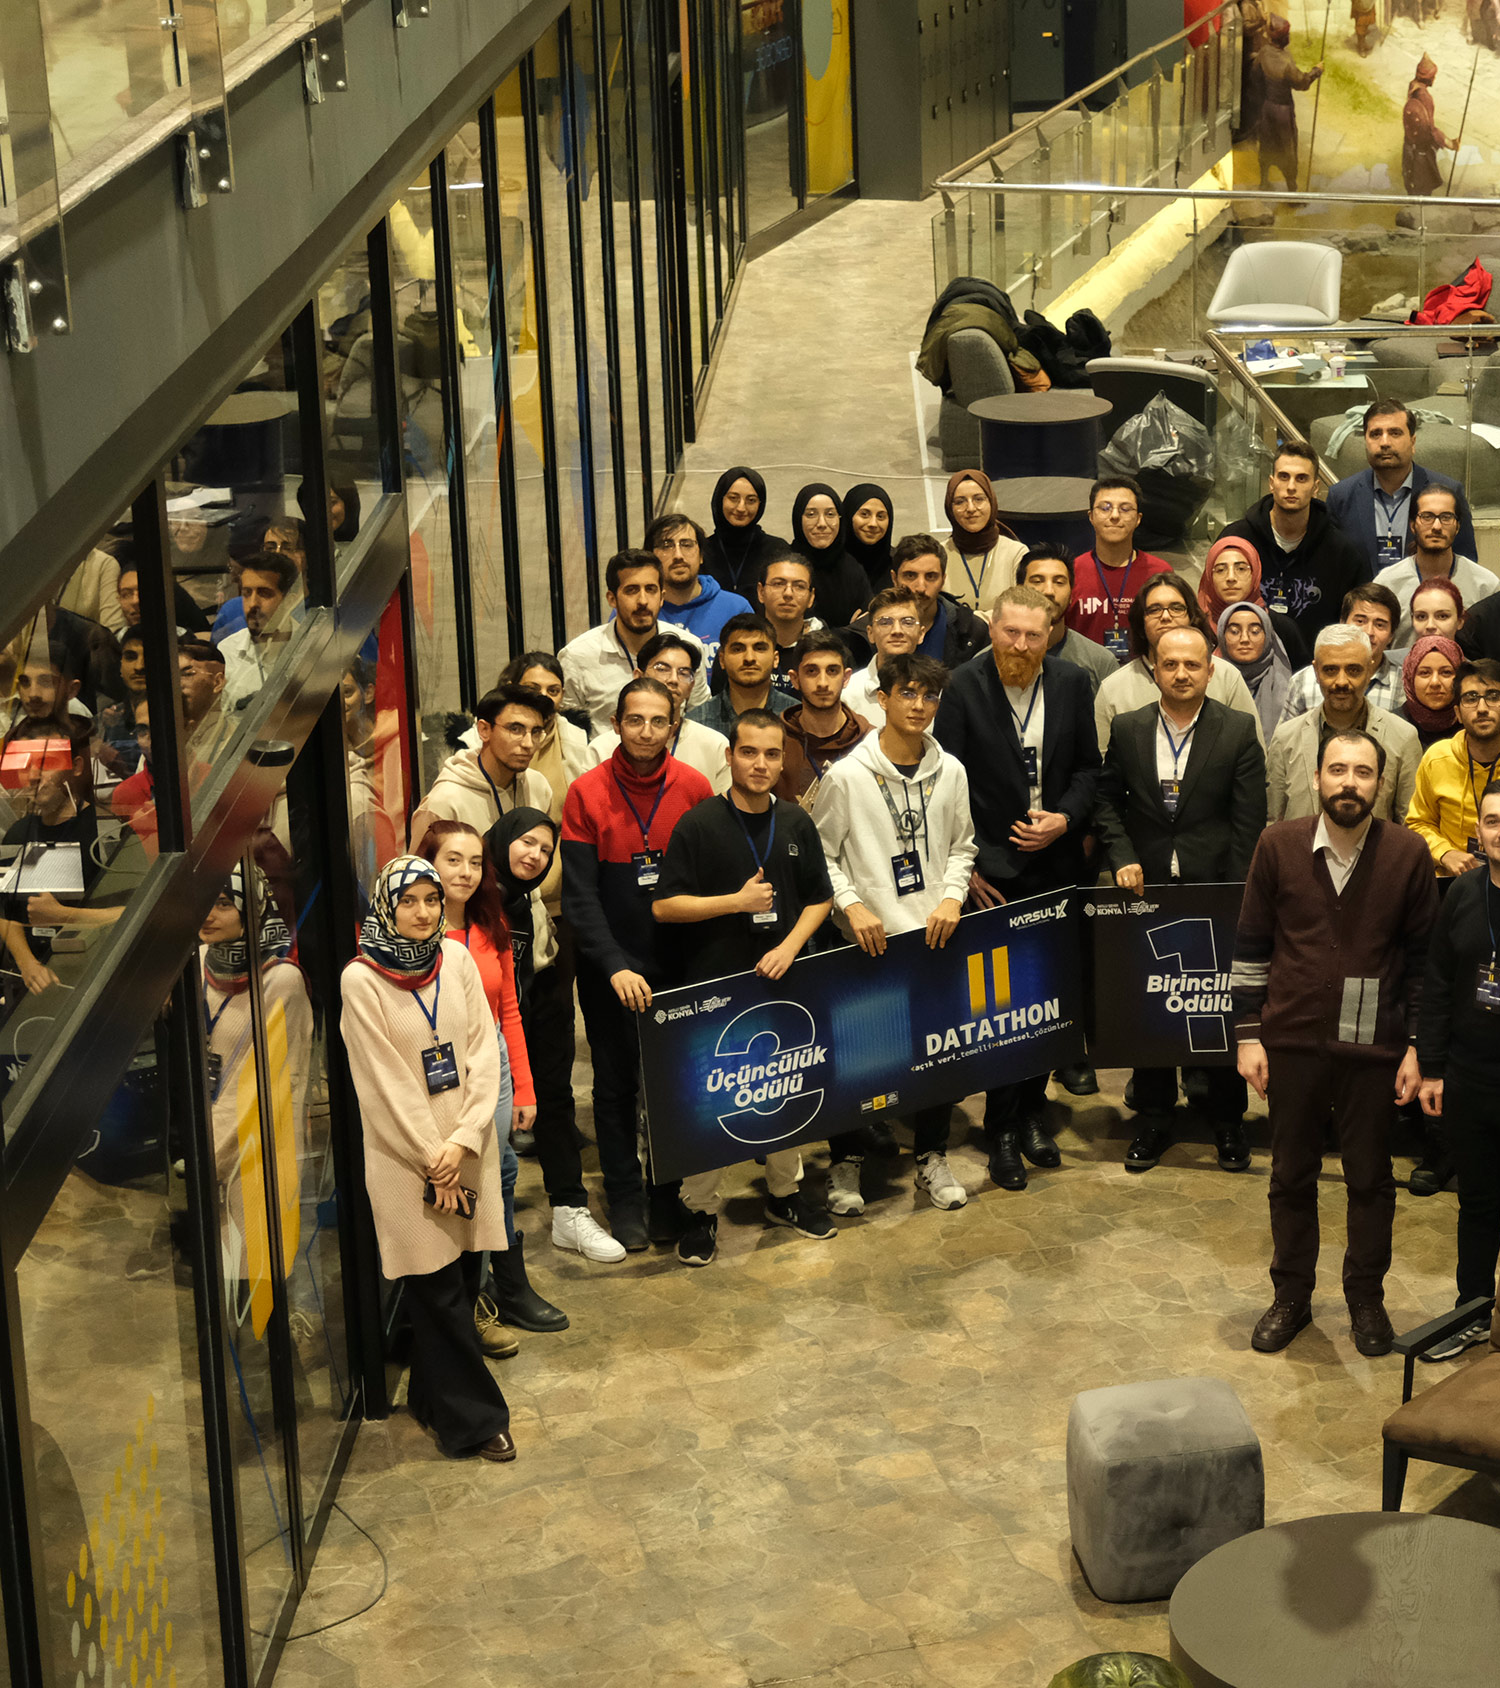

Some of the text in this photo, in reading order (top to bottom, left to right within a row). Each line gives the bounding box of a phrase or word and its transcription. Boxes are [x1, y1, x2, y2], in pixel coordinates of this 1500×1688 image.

[1097, 908, 1123, 916] KONYA
[1146, 973, 1232, 993] Birincili
[1165, 992, 1233, 1013] Ödülü
[667, 1009, 695, 1021] KONYA
[926, 997, 1061, 1057] DATATHON
[706, 1045, 828, 1093] Üçüncülük
[734, 1073, 804, 1108] Ödülü
